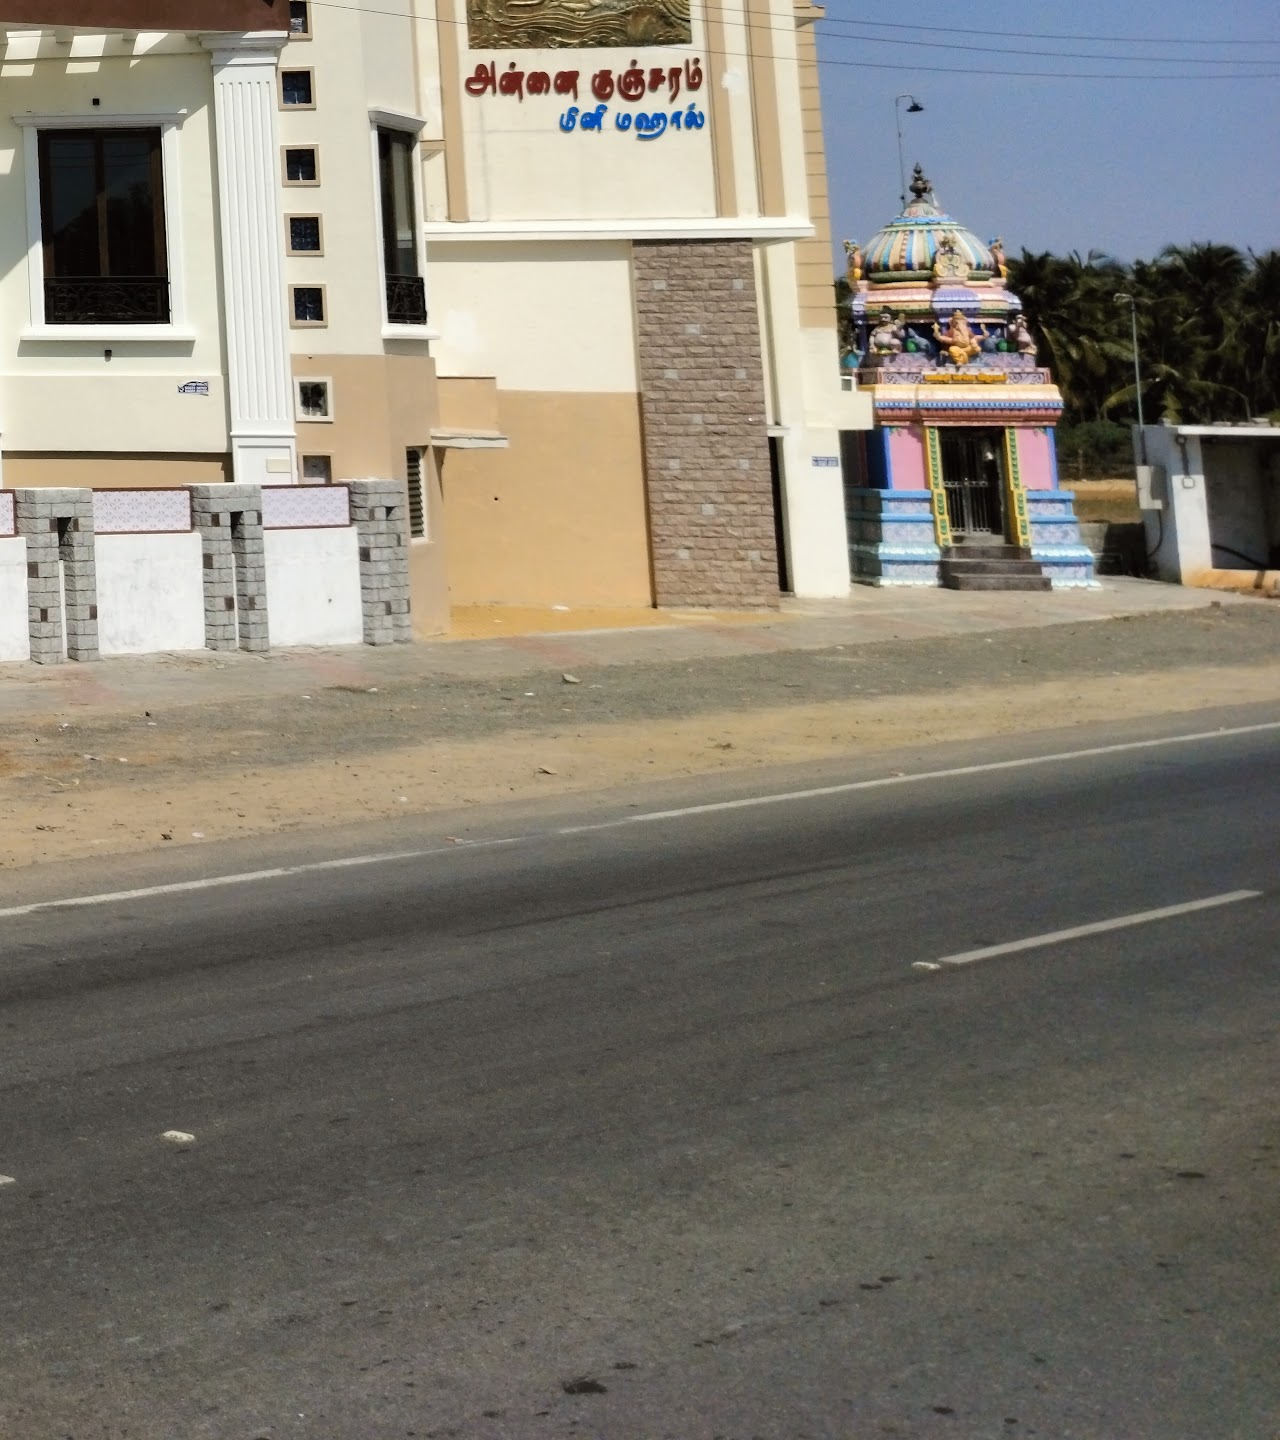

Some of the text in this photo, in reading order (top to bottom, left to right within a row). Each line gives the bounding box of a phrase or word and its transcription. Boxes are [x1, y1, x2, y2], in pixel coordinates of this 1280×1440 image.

[465, 57, 703, 104] அன்னை குஞ்சரம்
[559, 102, 705, 141] மினி மஹால்
